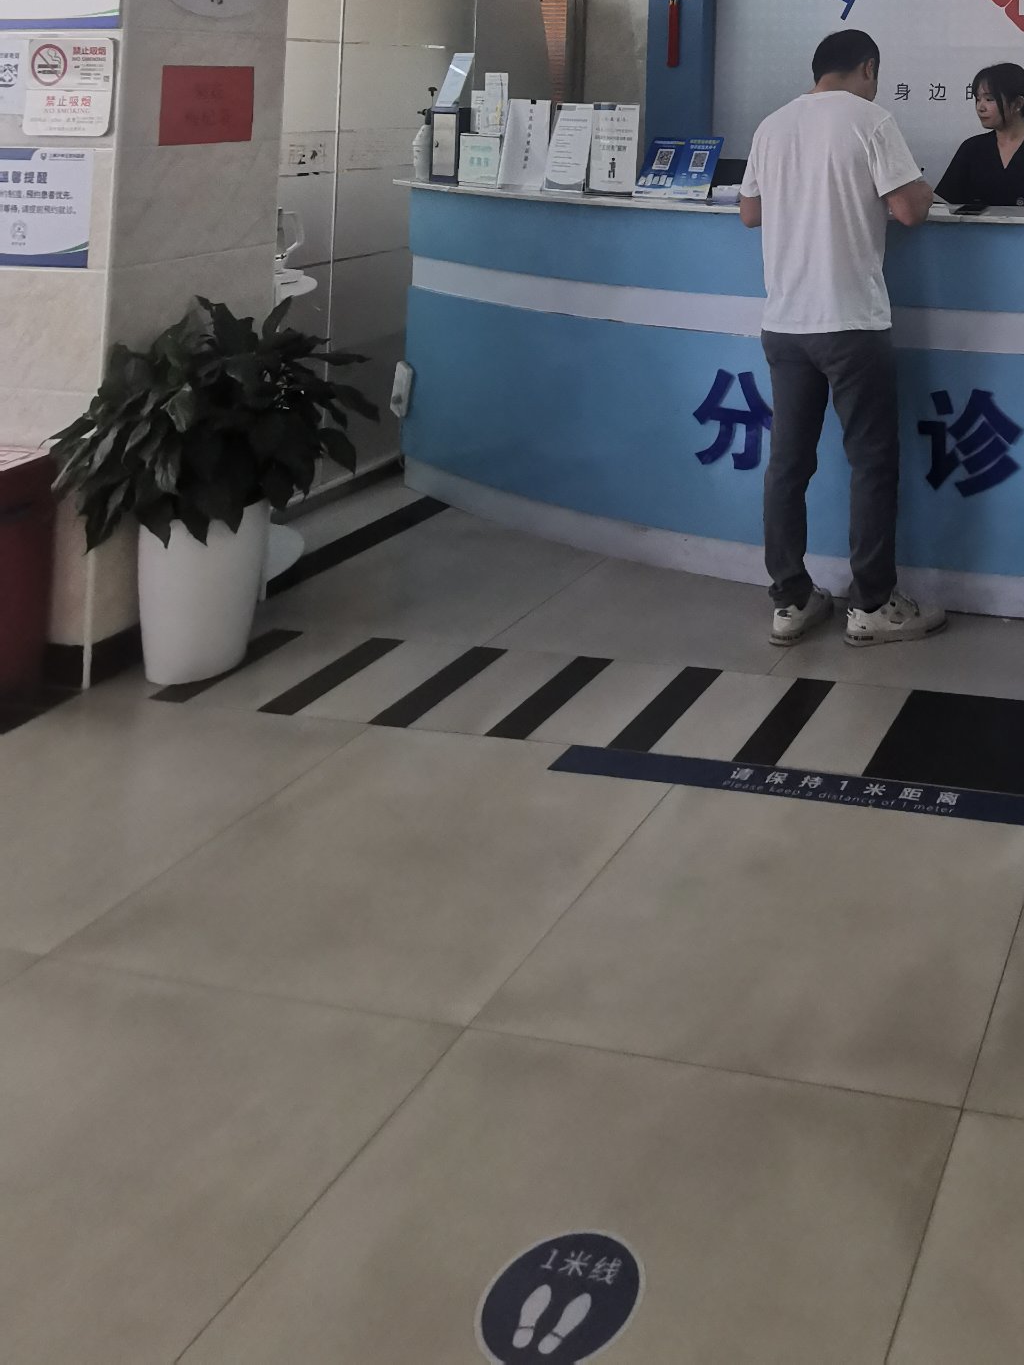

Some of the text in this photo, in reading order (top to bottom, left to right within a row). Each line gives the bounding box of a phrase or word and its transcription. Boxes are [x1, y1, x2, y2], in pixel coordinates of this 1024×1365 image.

[45, 96, 92, 107] 禁止吸烟
[730, 767, 961, 806] 请保持1米距离
[818, 792, 876, 805] distance
[881, 799, 895, 807] of
[913, 804, 955, 814] meter
[540, 1248, 623, 1285] 1米线
